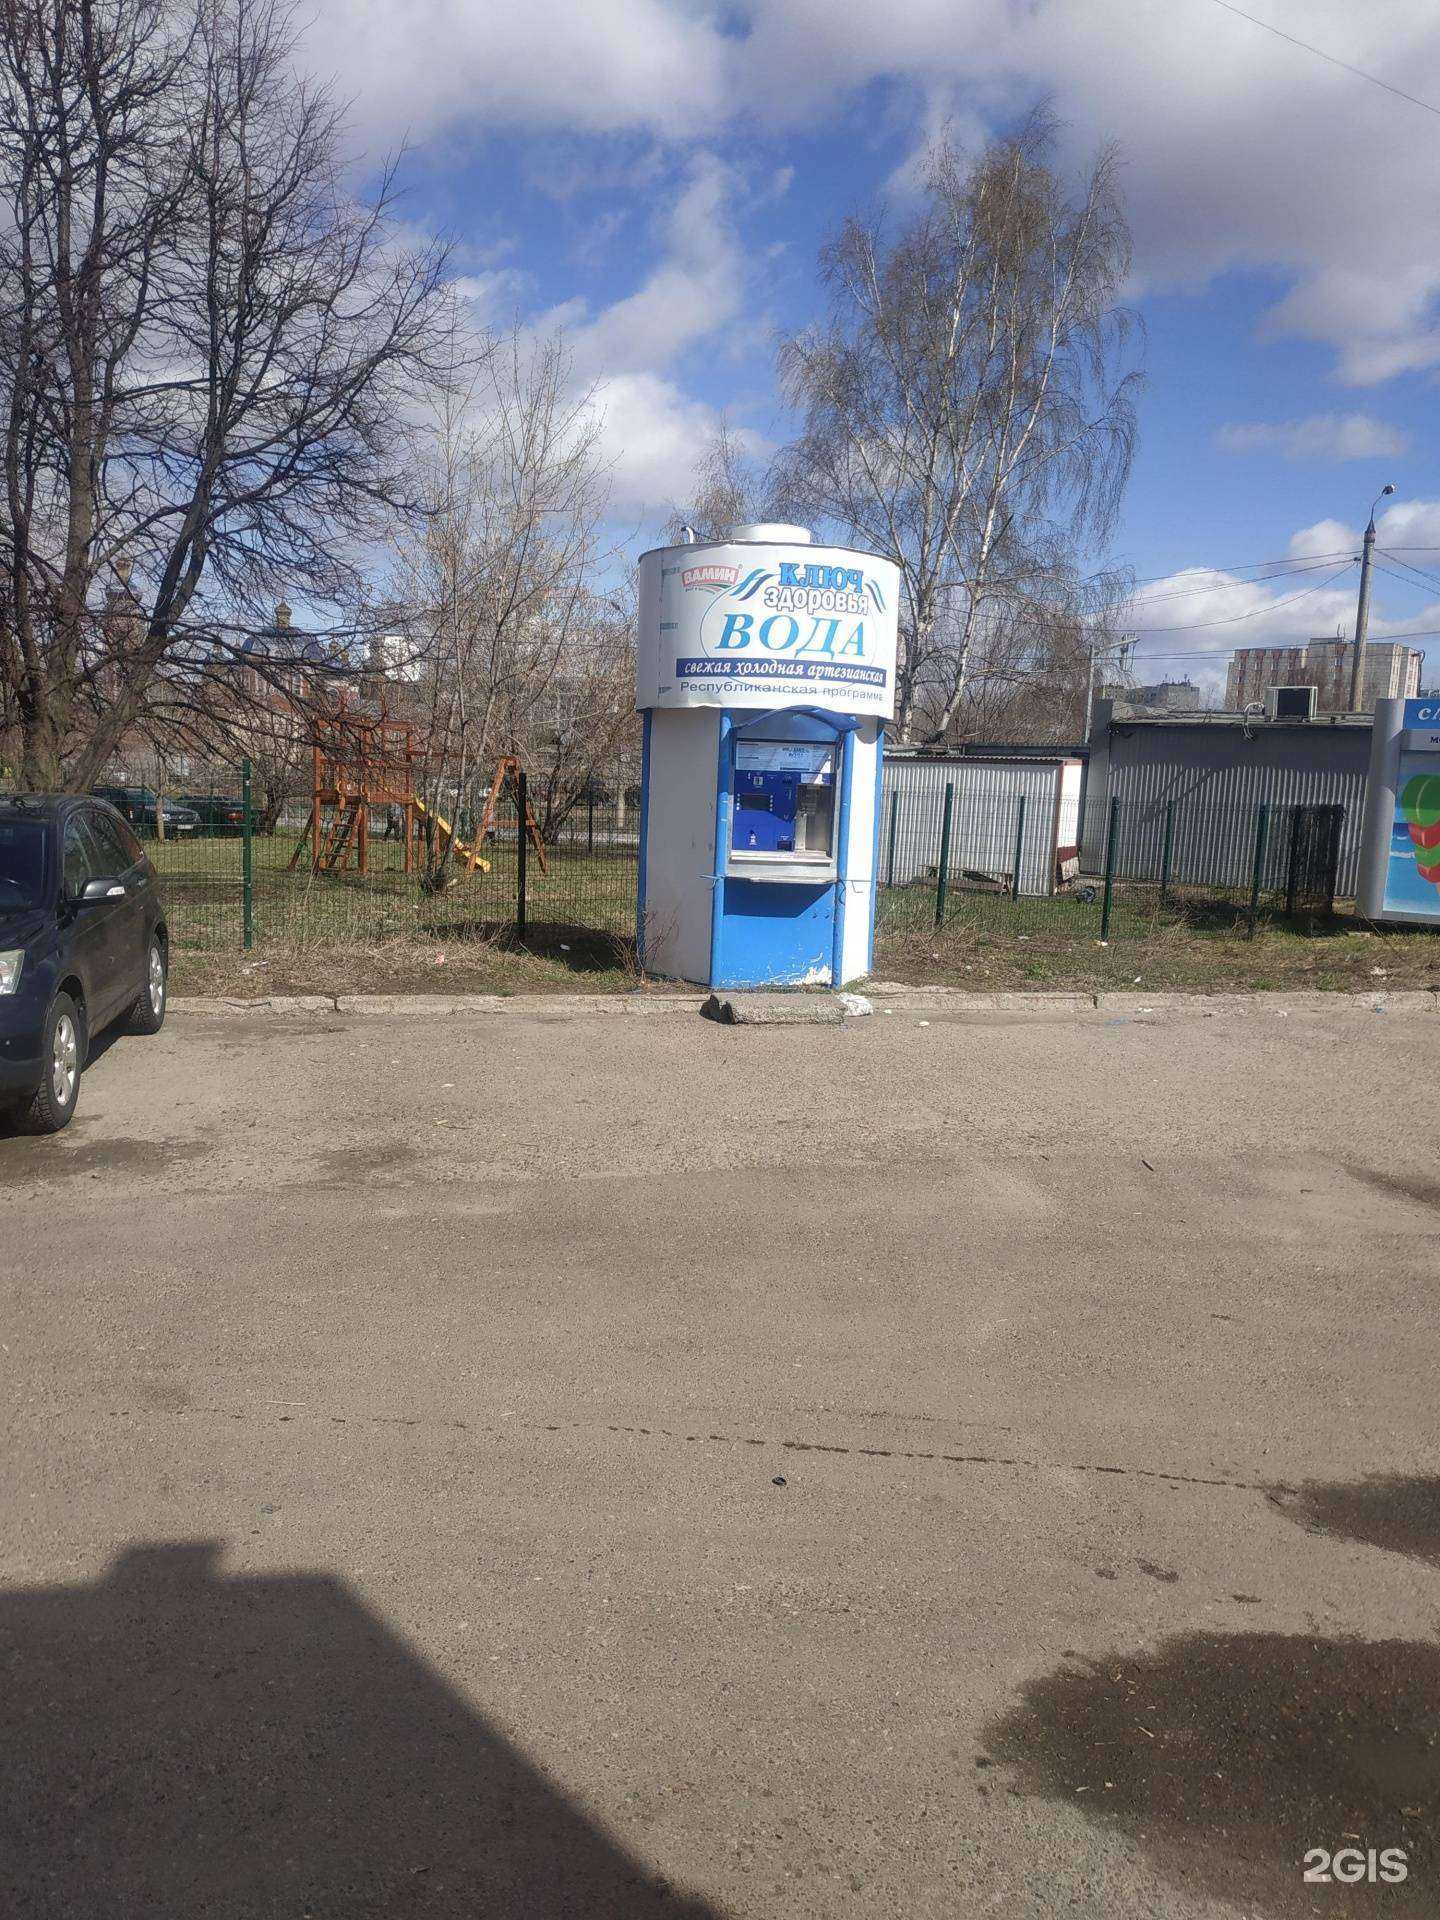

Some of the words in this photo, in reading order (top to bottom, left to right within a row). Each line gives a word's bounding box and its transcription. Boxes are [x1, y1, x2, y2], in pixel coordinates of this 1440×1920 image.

[714, 613, 866, 660] ВОДА
[684, 662, 731, 674] свежая
[734, 659, 804, 676] холодная
[807, 664, 883, 683] артезианская
[680, 681, 817, 695] Республиканская
